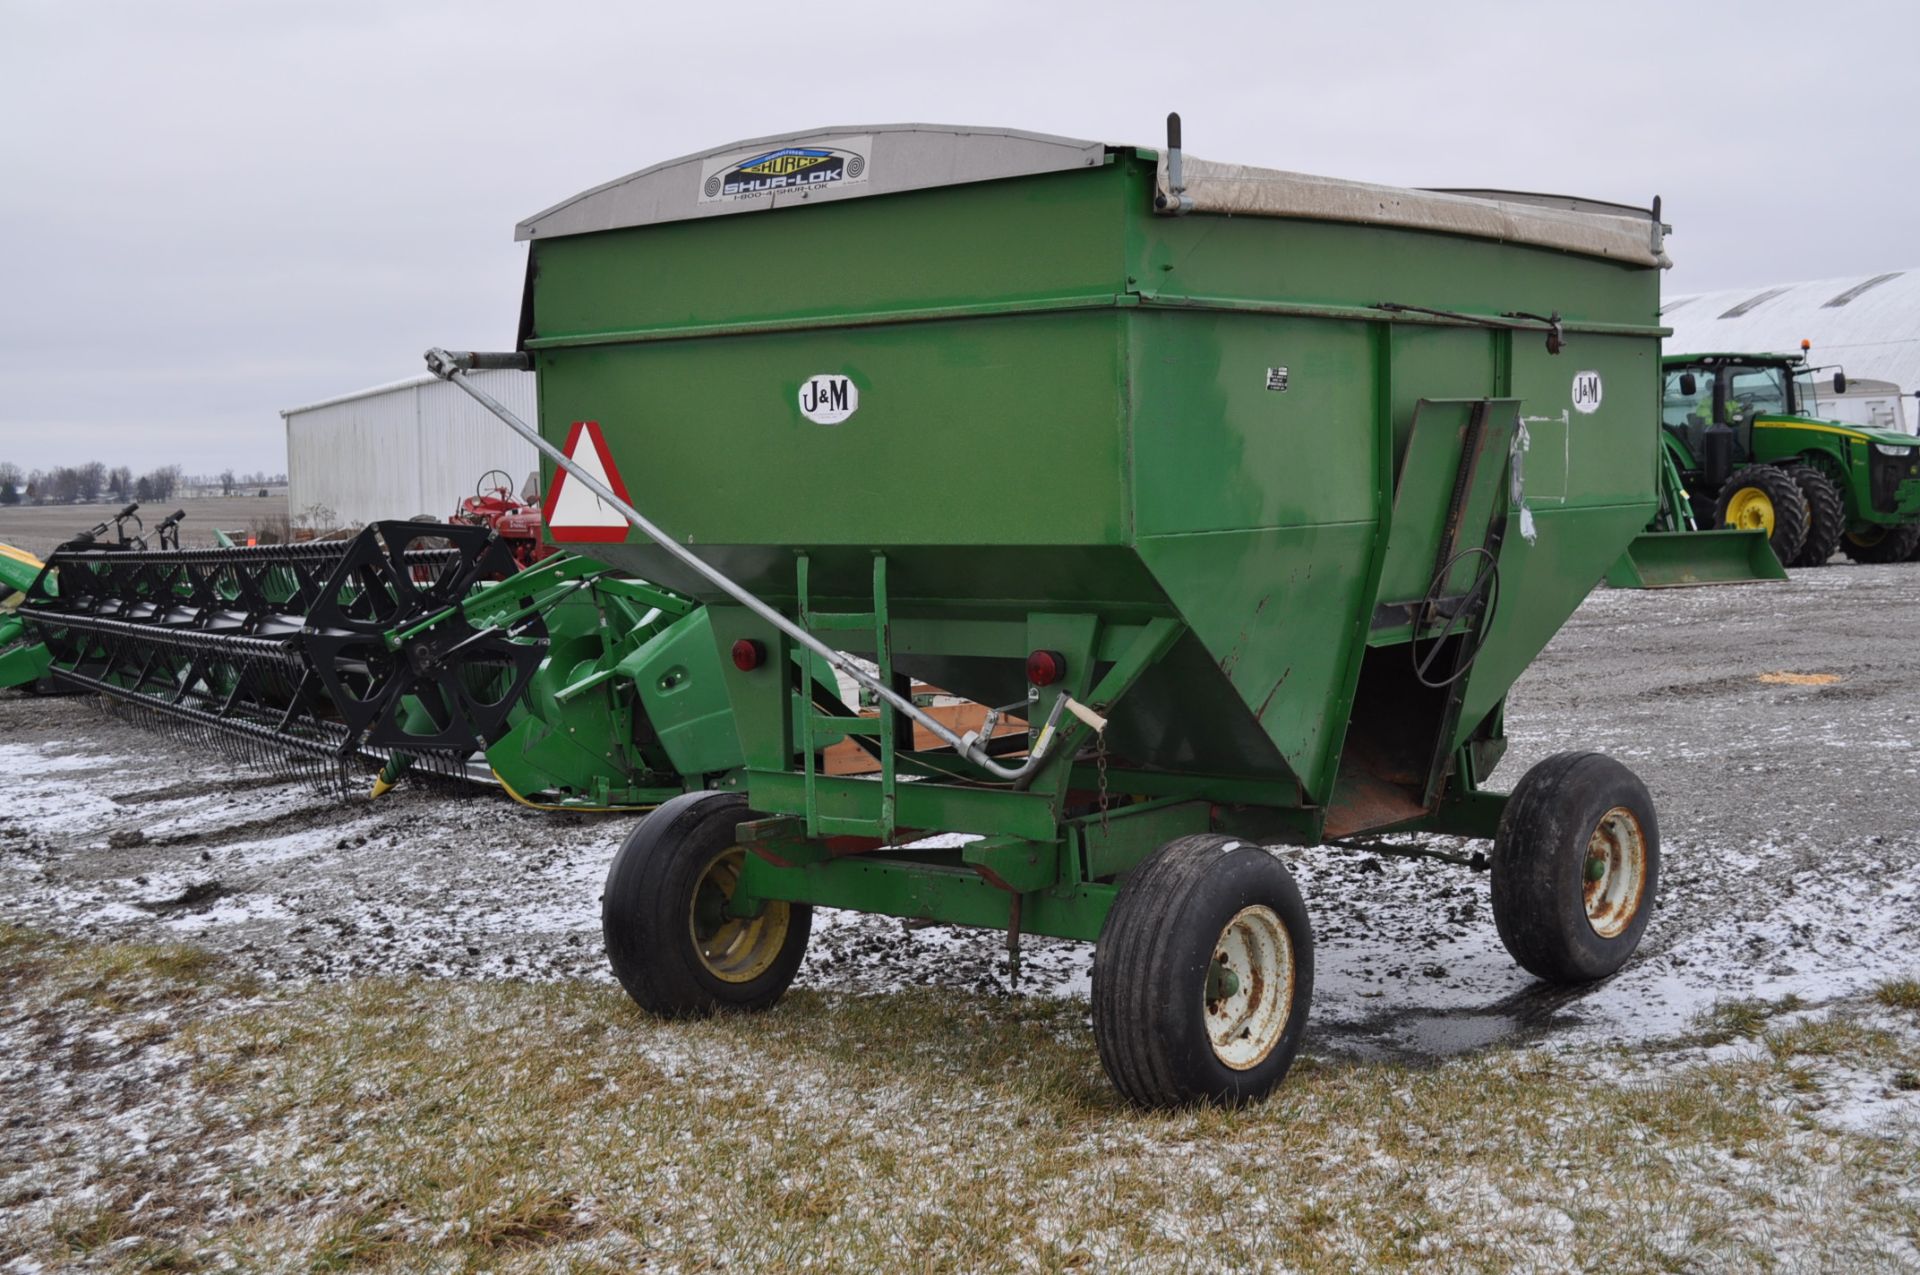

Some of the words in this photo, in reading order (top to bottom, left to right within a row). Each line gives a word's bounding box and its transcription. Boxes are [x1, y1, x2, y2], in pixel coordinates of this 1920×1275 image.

[724, 169, 842, 195] SHUR-LOK
[803, 379, 849, 412] J&M
[1574, 377, 1598, 404] J&M
